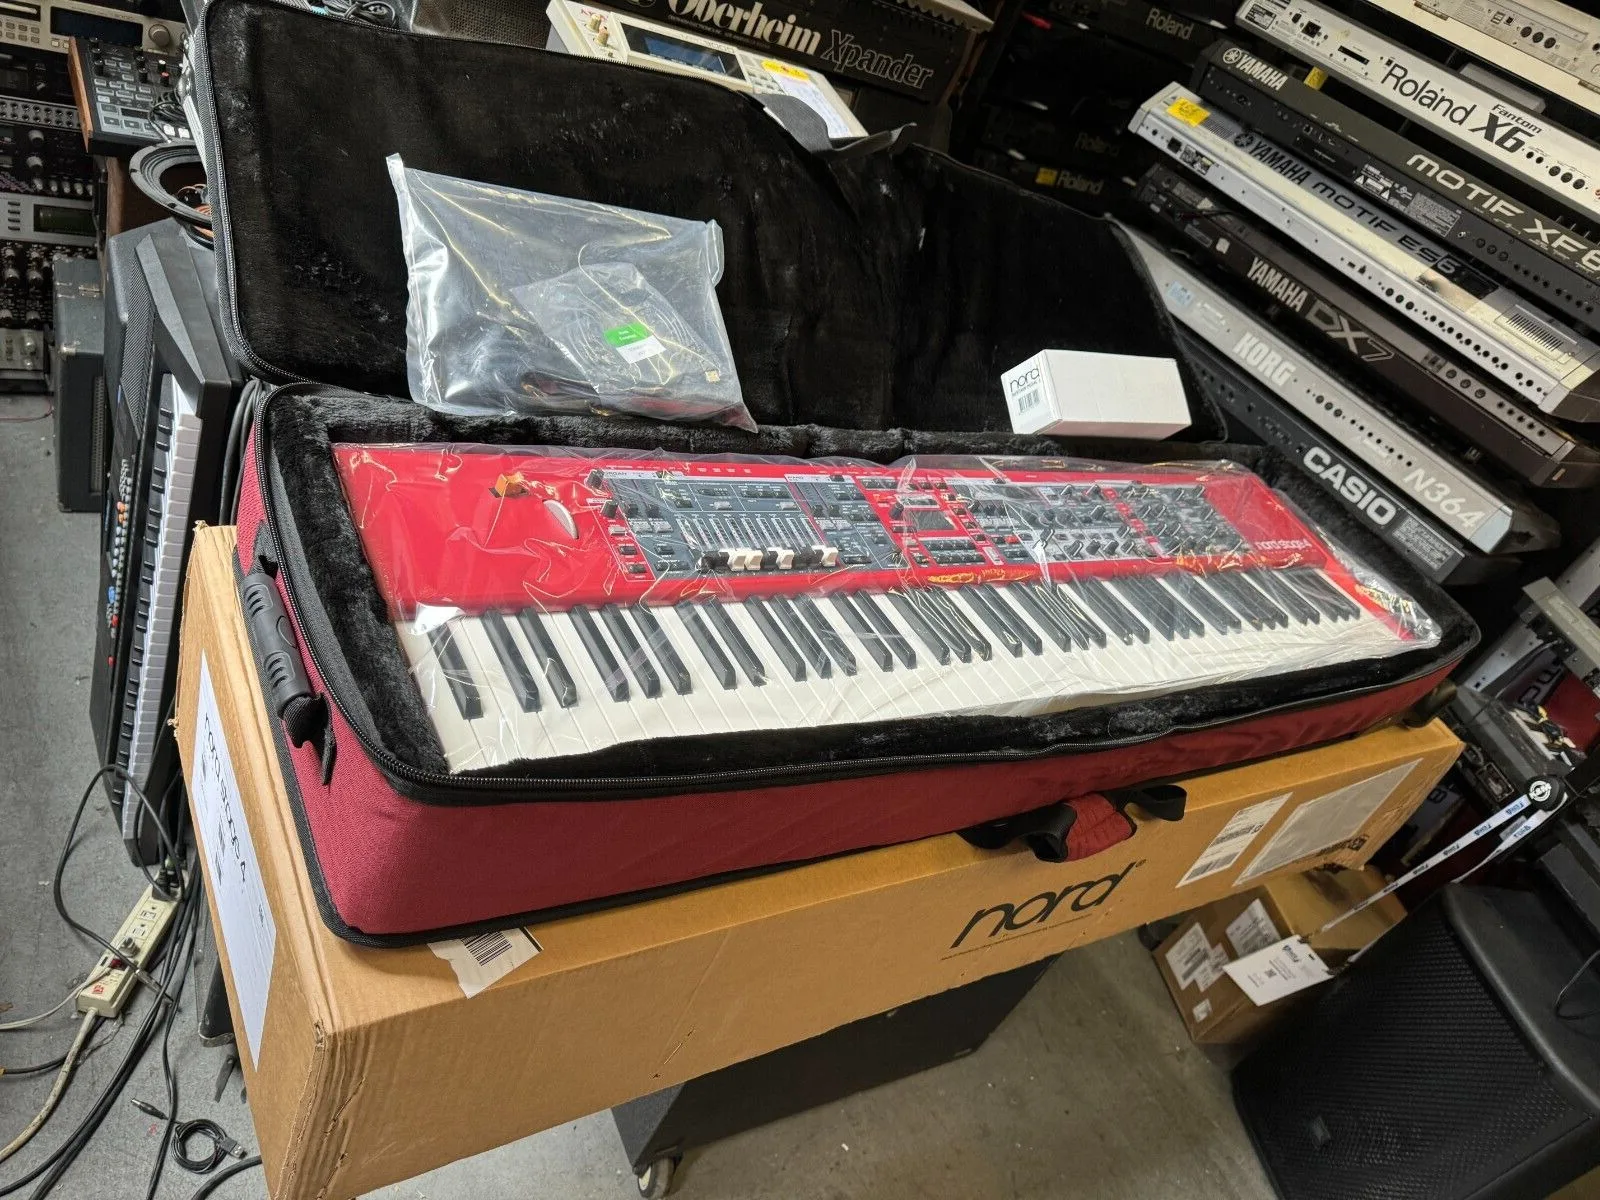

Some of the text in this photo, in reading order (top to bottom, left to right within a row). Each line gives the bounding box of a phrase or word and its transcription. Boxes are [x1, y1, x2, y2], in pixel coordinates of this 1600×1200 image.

[1146, 8, 1194, 41] Roland
[821, 30, 934, 89] Xpander
[1239, 52, 1289, 92] YAMAHA
[1380, 61, 1478, 127] Roland
[1490, 103, 1544, 135] Fantom
[1467, 112, 1537, 155] X6
[1056, 172, 1105, 196] Roland
[1249, 141, 1313, 185] YAMAHA
[1311, 181, 1399, 234] MOTIF
[1396, 234, 1462, 276] ES6
[1406, 153, 1525, 218] MOTIF
[1246, 256, 1395, 363] YAMAHA DX7
[1010, 367, 1039, 392] nord
[1233, 331, 1297, 387] KORG
[1302, 446, 1398, 526] CASIO
[1402, 467, 1487, 531] N364
[950, 861, 1137, 949] nord
